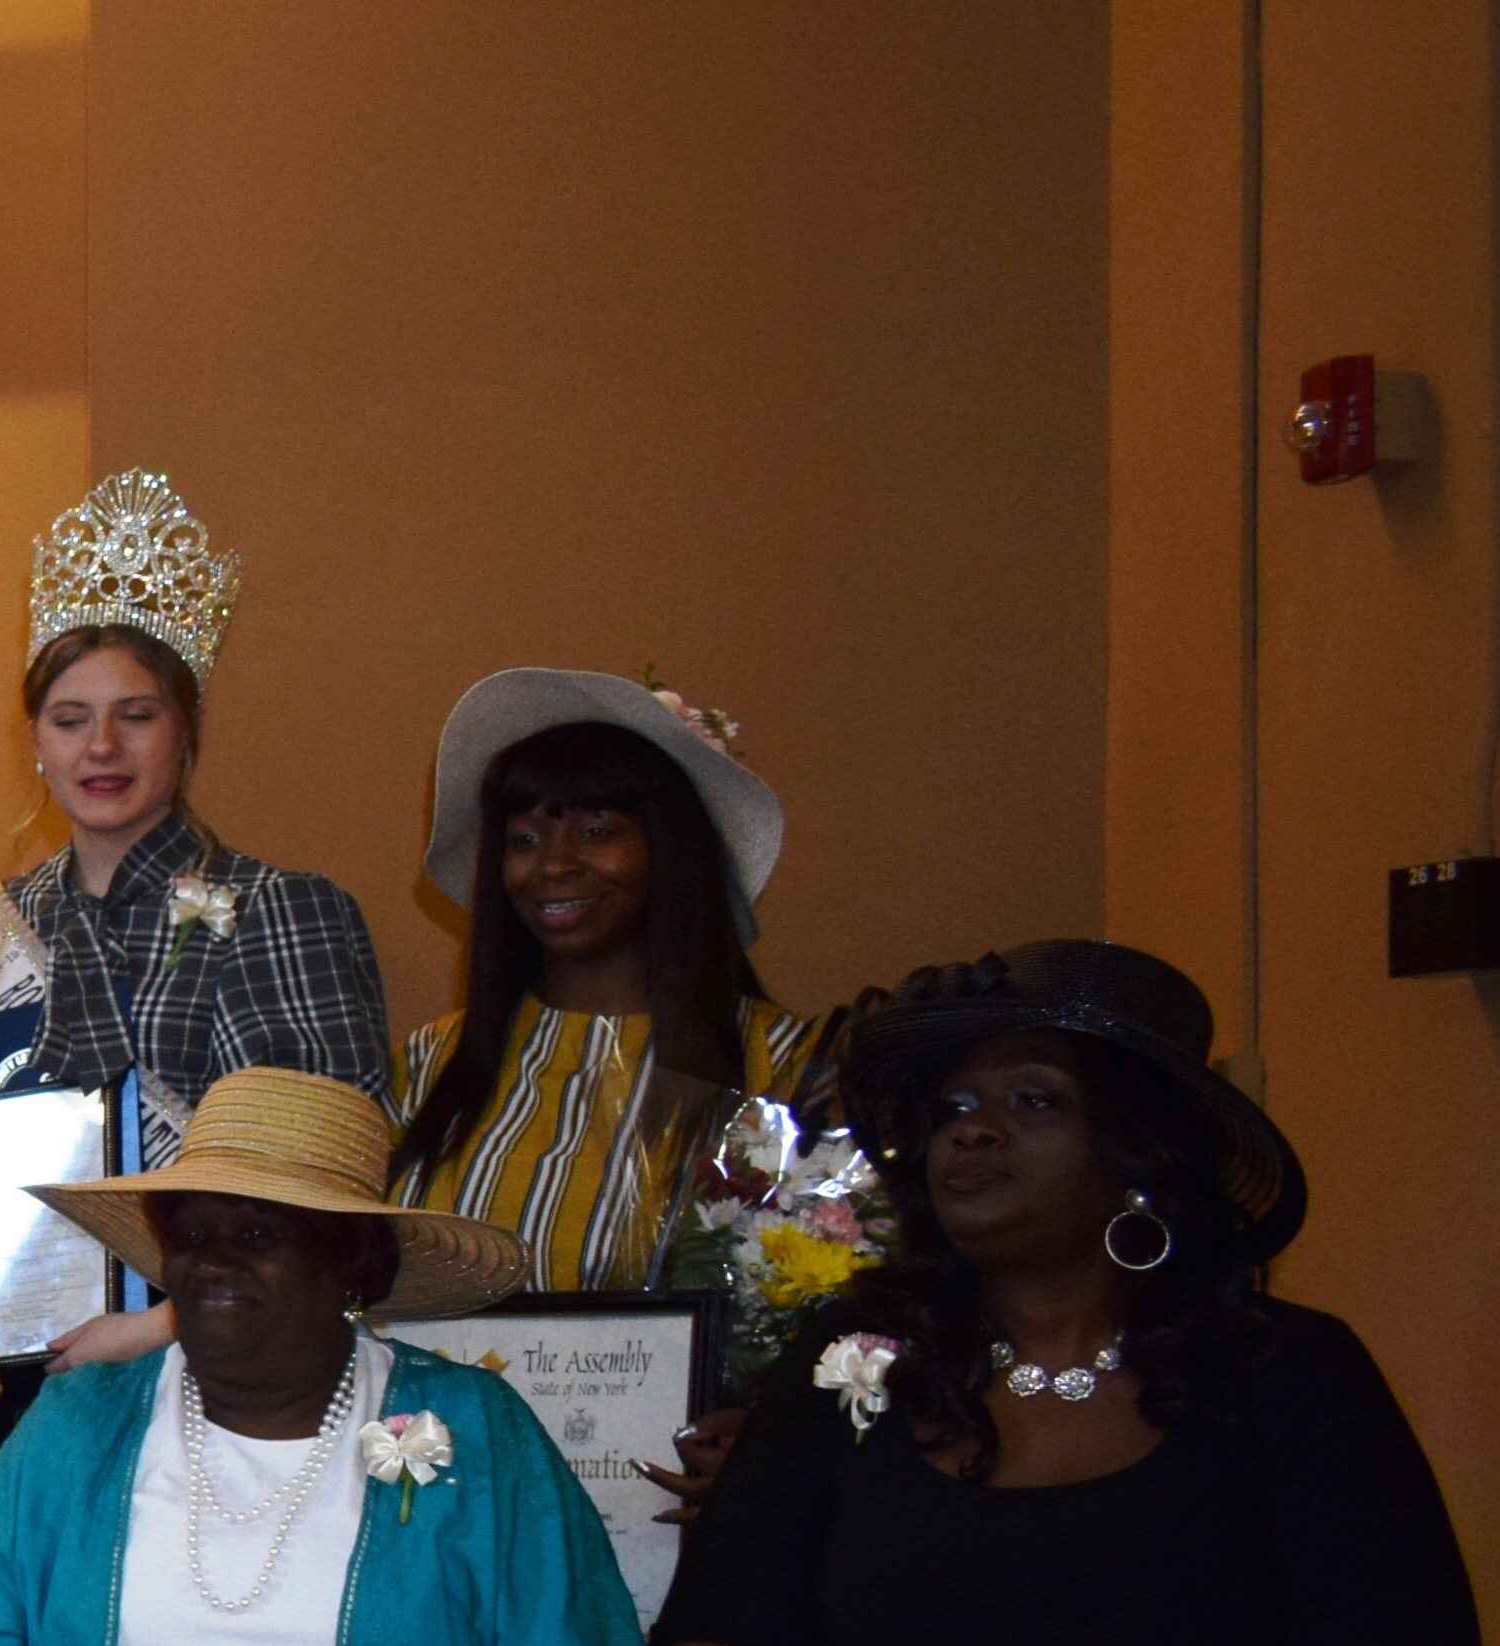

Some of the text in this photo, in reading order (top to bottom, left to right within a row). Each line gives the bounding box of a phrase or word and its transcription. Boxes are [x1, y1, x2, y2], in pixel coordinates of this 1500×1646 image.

[1409, 862, 1457, 886] 26 28
[523, 1340, 653, 1387] The Assembly
[531, 1381, 628, 1402] State of New York
